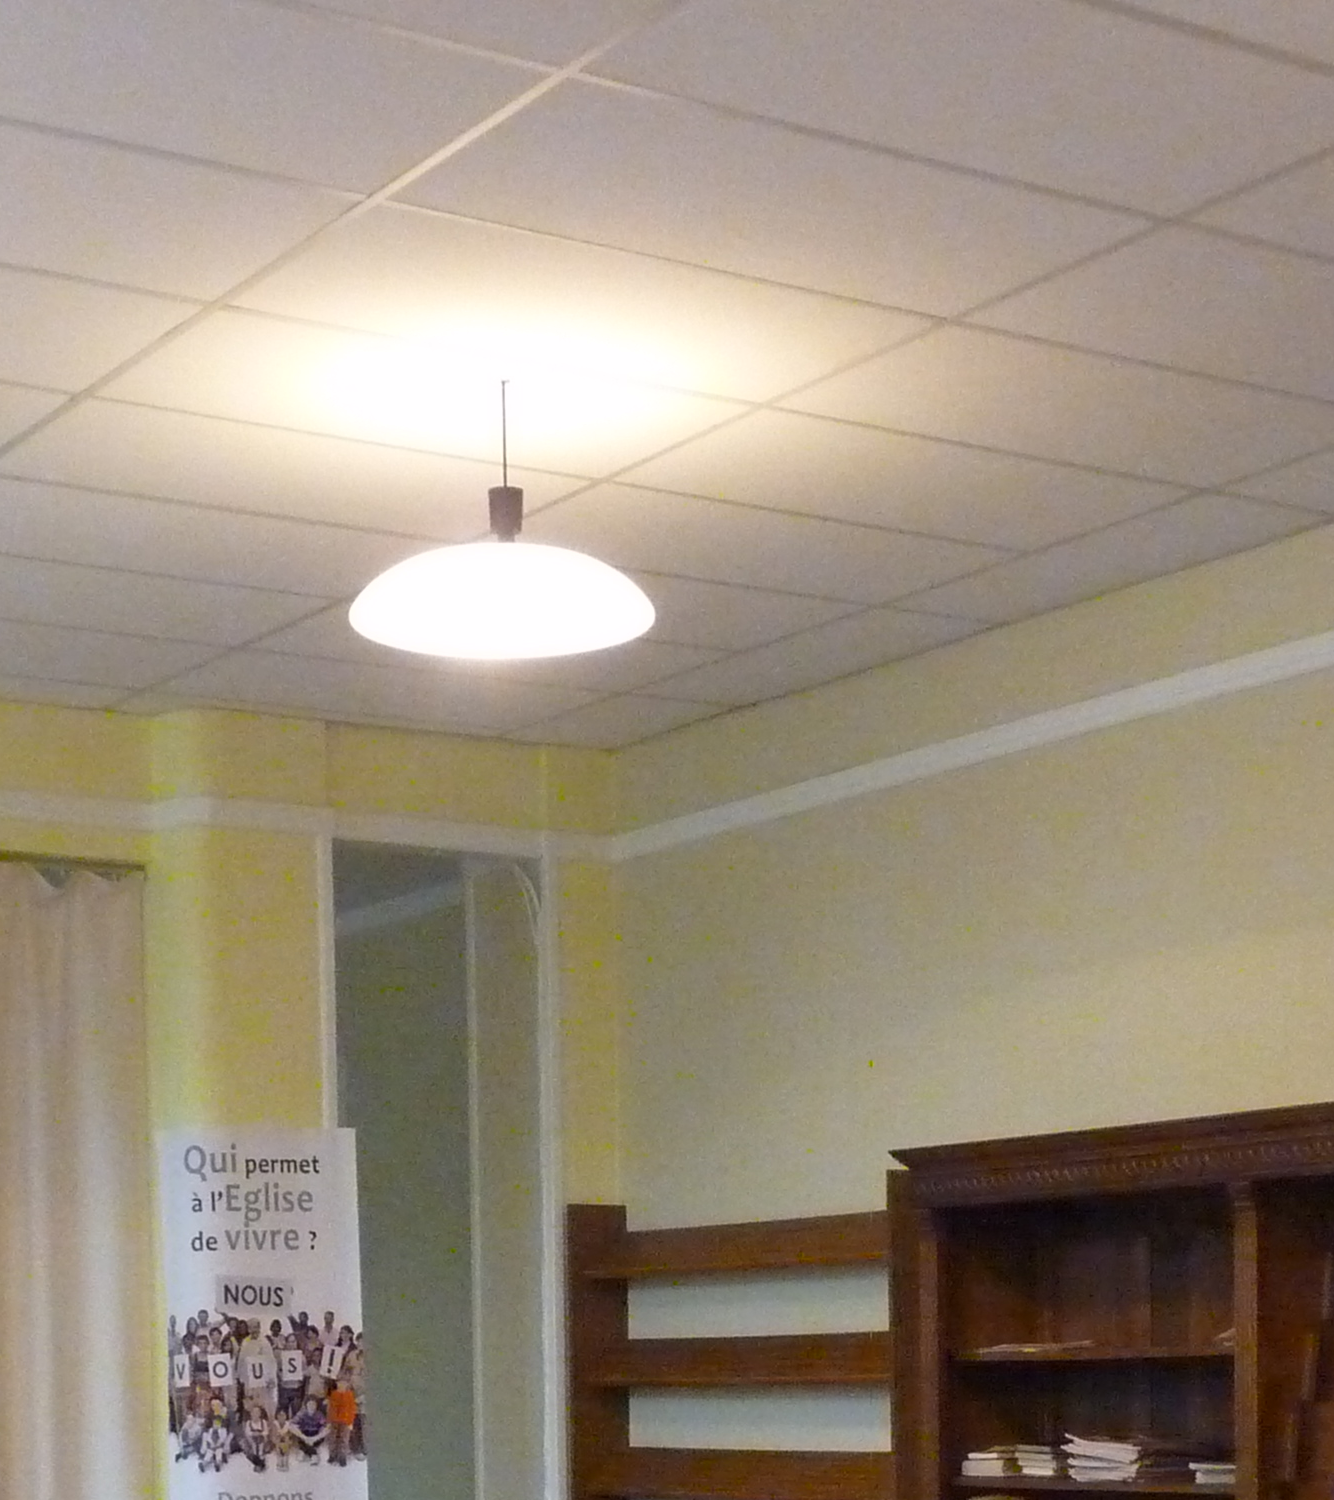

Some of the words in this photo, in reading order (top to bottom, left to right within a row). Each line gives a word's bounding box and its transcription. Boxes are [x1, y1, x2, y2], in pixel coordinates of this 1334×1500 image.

[184, 1143, 237, 1182] Qui
[245, 1156, 320, 1179] permet
[192, 1192, 203, 1213] à
[191, 1231, 218, 1251] de
[224, 1222, 300, 1250] vivre
[223, 1284, 284, 1307] NOUS
